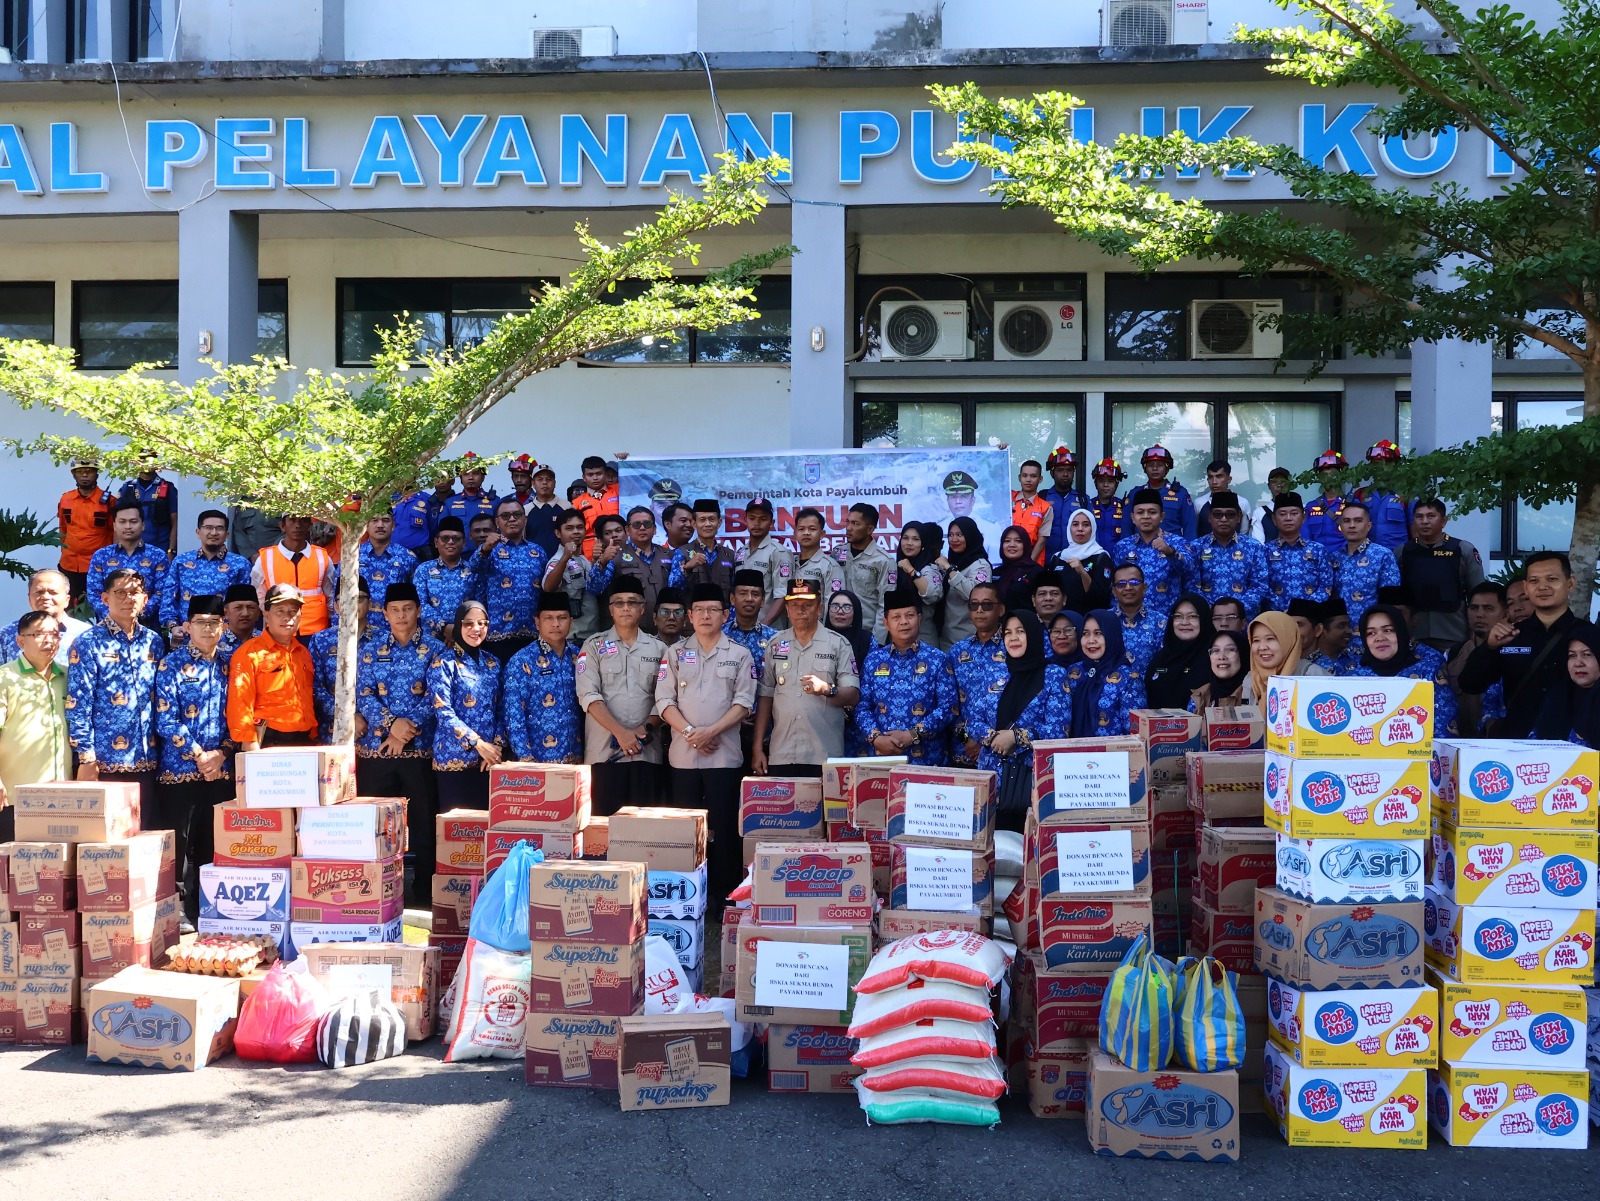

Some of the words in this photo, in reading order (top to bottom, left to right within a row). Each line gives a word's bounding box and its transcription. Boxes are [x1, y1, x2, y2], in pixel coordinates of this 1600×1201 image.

[145, 111, 794, 191] PELAYANAN
[838, 104, 1254, 185] PUIK
[718, 489, 790, 500] Pemerintah
[794, 488, 823, 498] Kota
[826, 485, 908, 499] Payakumbuh
[724, 504, 902, 533] BNUN
[1313, 699, 1337, 718] POP
[1353, 693, 1387, 709] LAPEER
[1359, 703, 1385, 716] TIME
[1320, 708, 1347, 728] MIE
[1389, 723, 1411, 733] KARI
[1388, 732, 1414, 741] AYAM
[1475, 767, 1500, 788] POP
[1516, 763, 1550, 777] LAPEER
[1347, 773, 1380, 788] LAPEER
[1522, 772, 1548, 785] TIME
[258, 788, 306, 796] PAYAKUMBUH
[1307, 778, 1331, 797] POP
[1353, 783, 1379, 796] TIME
[1482, 777, 1510, 797] MIE
[1314, 787, 1341, 807] MIE
[1552, 792, 1574, 801] KARI
[507, 805, 521, 816] Mi
[521, 807, 560, 820] goreng
[1551, 801, 1577, 810] AYAM
[759, 818, 777, 827] Kari
[777, 818, 800, 829] Ayam
[243, 834, 263, 846] Mi
[230, 843, 277, 857] Goreng
[781, 858, 802, 866] Mie
[846, 855, 863, 865] 20
[1285, 853, 1307, 875] Asri
[1340, 848, 1412, 879] Asri
[311, 868, 362, 888] Sukses's
[771, 865, 855, 884] Sedaap
[1546, 861, 1574, 880] MIE
[1073, 879, 1119, 887] PAYAKUMBUH
[1508, 872, 1536, 885] TIME
[1556, 870, 1582, 890] POP
[214, 882, 270, 905] AQEZ
[359, 879, 372, 895] 2
[1404, 882, 1419, 892] SNI
[1506, 881, 1540, 895] LAPEER
[595, 902, 620, 914] Resep
[827, 909, 867, 918] GORENG
[1480, 925, 1505, 944] POP
[1520, 920, 1553, 934] LAPEER
[1329, 923, 1408, 958] Asri
[1525, 930, 1550, 942] TIME
[1487, 935, 1514, 953] MIE
[1066, 950, 1091, 959] Kari
[1091, 950, 1122, 962] Ayam
[594, 975, 620, 987] Resep
[779, 988, 823, 997] PAYAKUMBUH
[1321, 1008, 1345, 1027] POP
[1360, 1002, 1393, 1018] LAPEER
[113, 1010, 182, 1043] Asri
[1365, 1012, 1391, 1026] TIME
[46, 1029, 64, 1037] 40
[1328, 1017, 1354, 1037] MIE
[1534, 1021, 1561, 1039] MIE
[1495, 1029, 1522, 1042] TIME
[1543, 1030, 1569, 1048] POP
[1492, 1038, 1527, 1051] LAPEER
[1304, 1086, 1328, 1104] POP
[1344, 1080, 1377, 1096] LAPEER
[1349, 1090, 1375, 1103] TIME
[1129, 1093, 1219, 1129] Asri
[1311, 1095, 1338, 1114] MIE
[1540, 1100, 1567, 1120] MIE
[1502, 1112, 1528, 1125] TIME
[1549, 1110, 1574, 1130] POP
[1500, 1121, 1534, 1135] LAPEER
